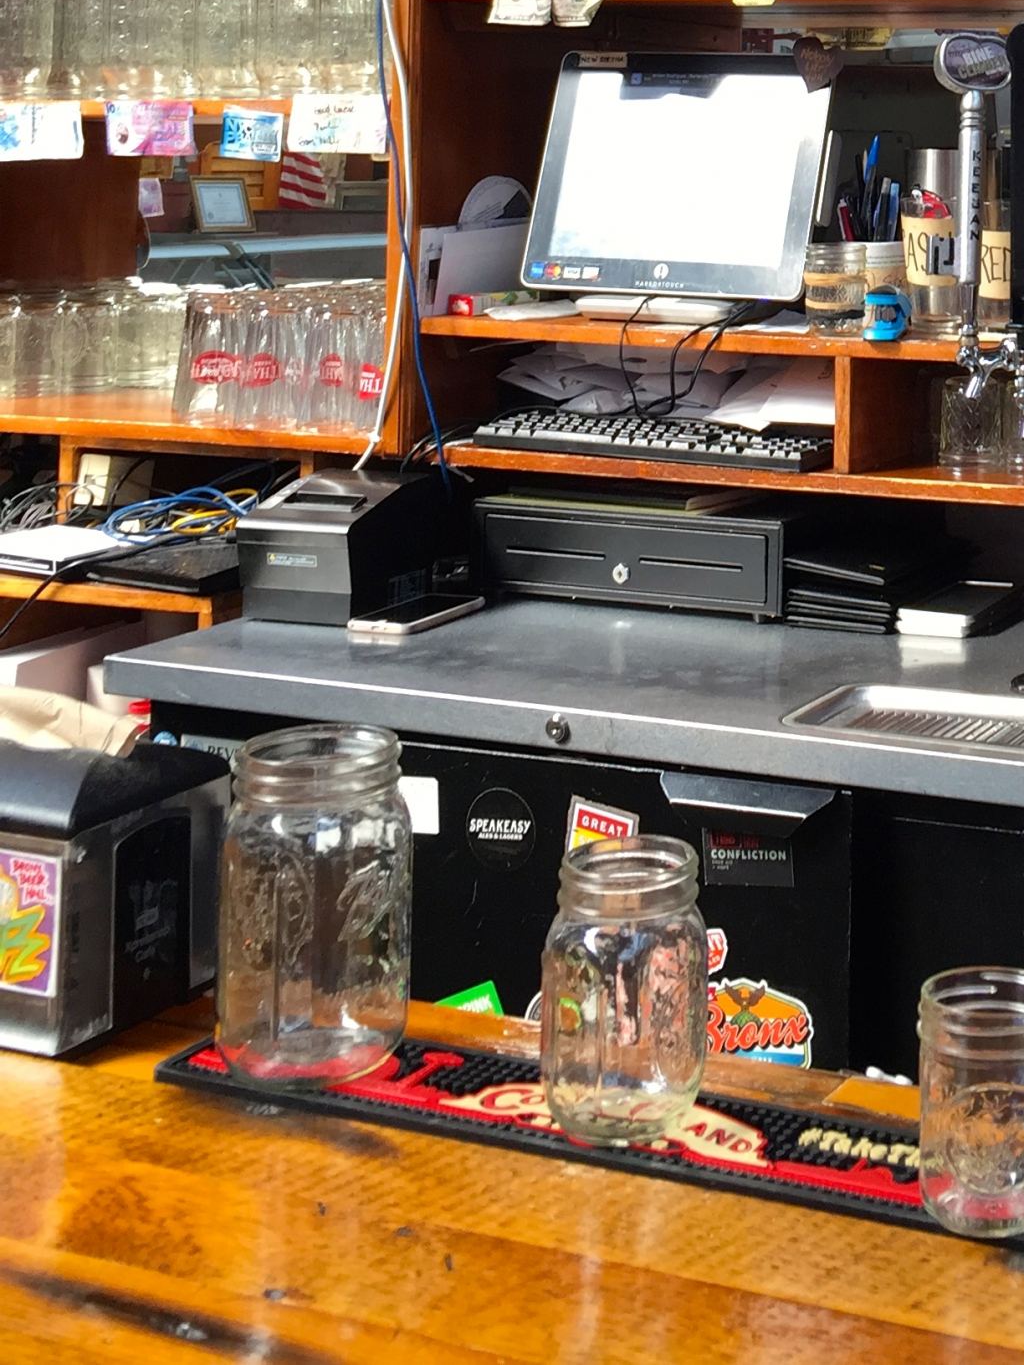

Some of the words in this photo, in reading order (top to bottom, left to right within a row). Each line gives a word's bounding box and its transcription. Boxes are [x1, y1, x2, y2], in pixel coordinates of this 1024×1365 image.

[469, 817, 532, 834] SPEAKEASY
[581, 814, 623, 837] GREAT
[711, 848, 787, 861] CONFLICTION
